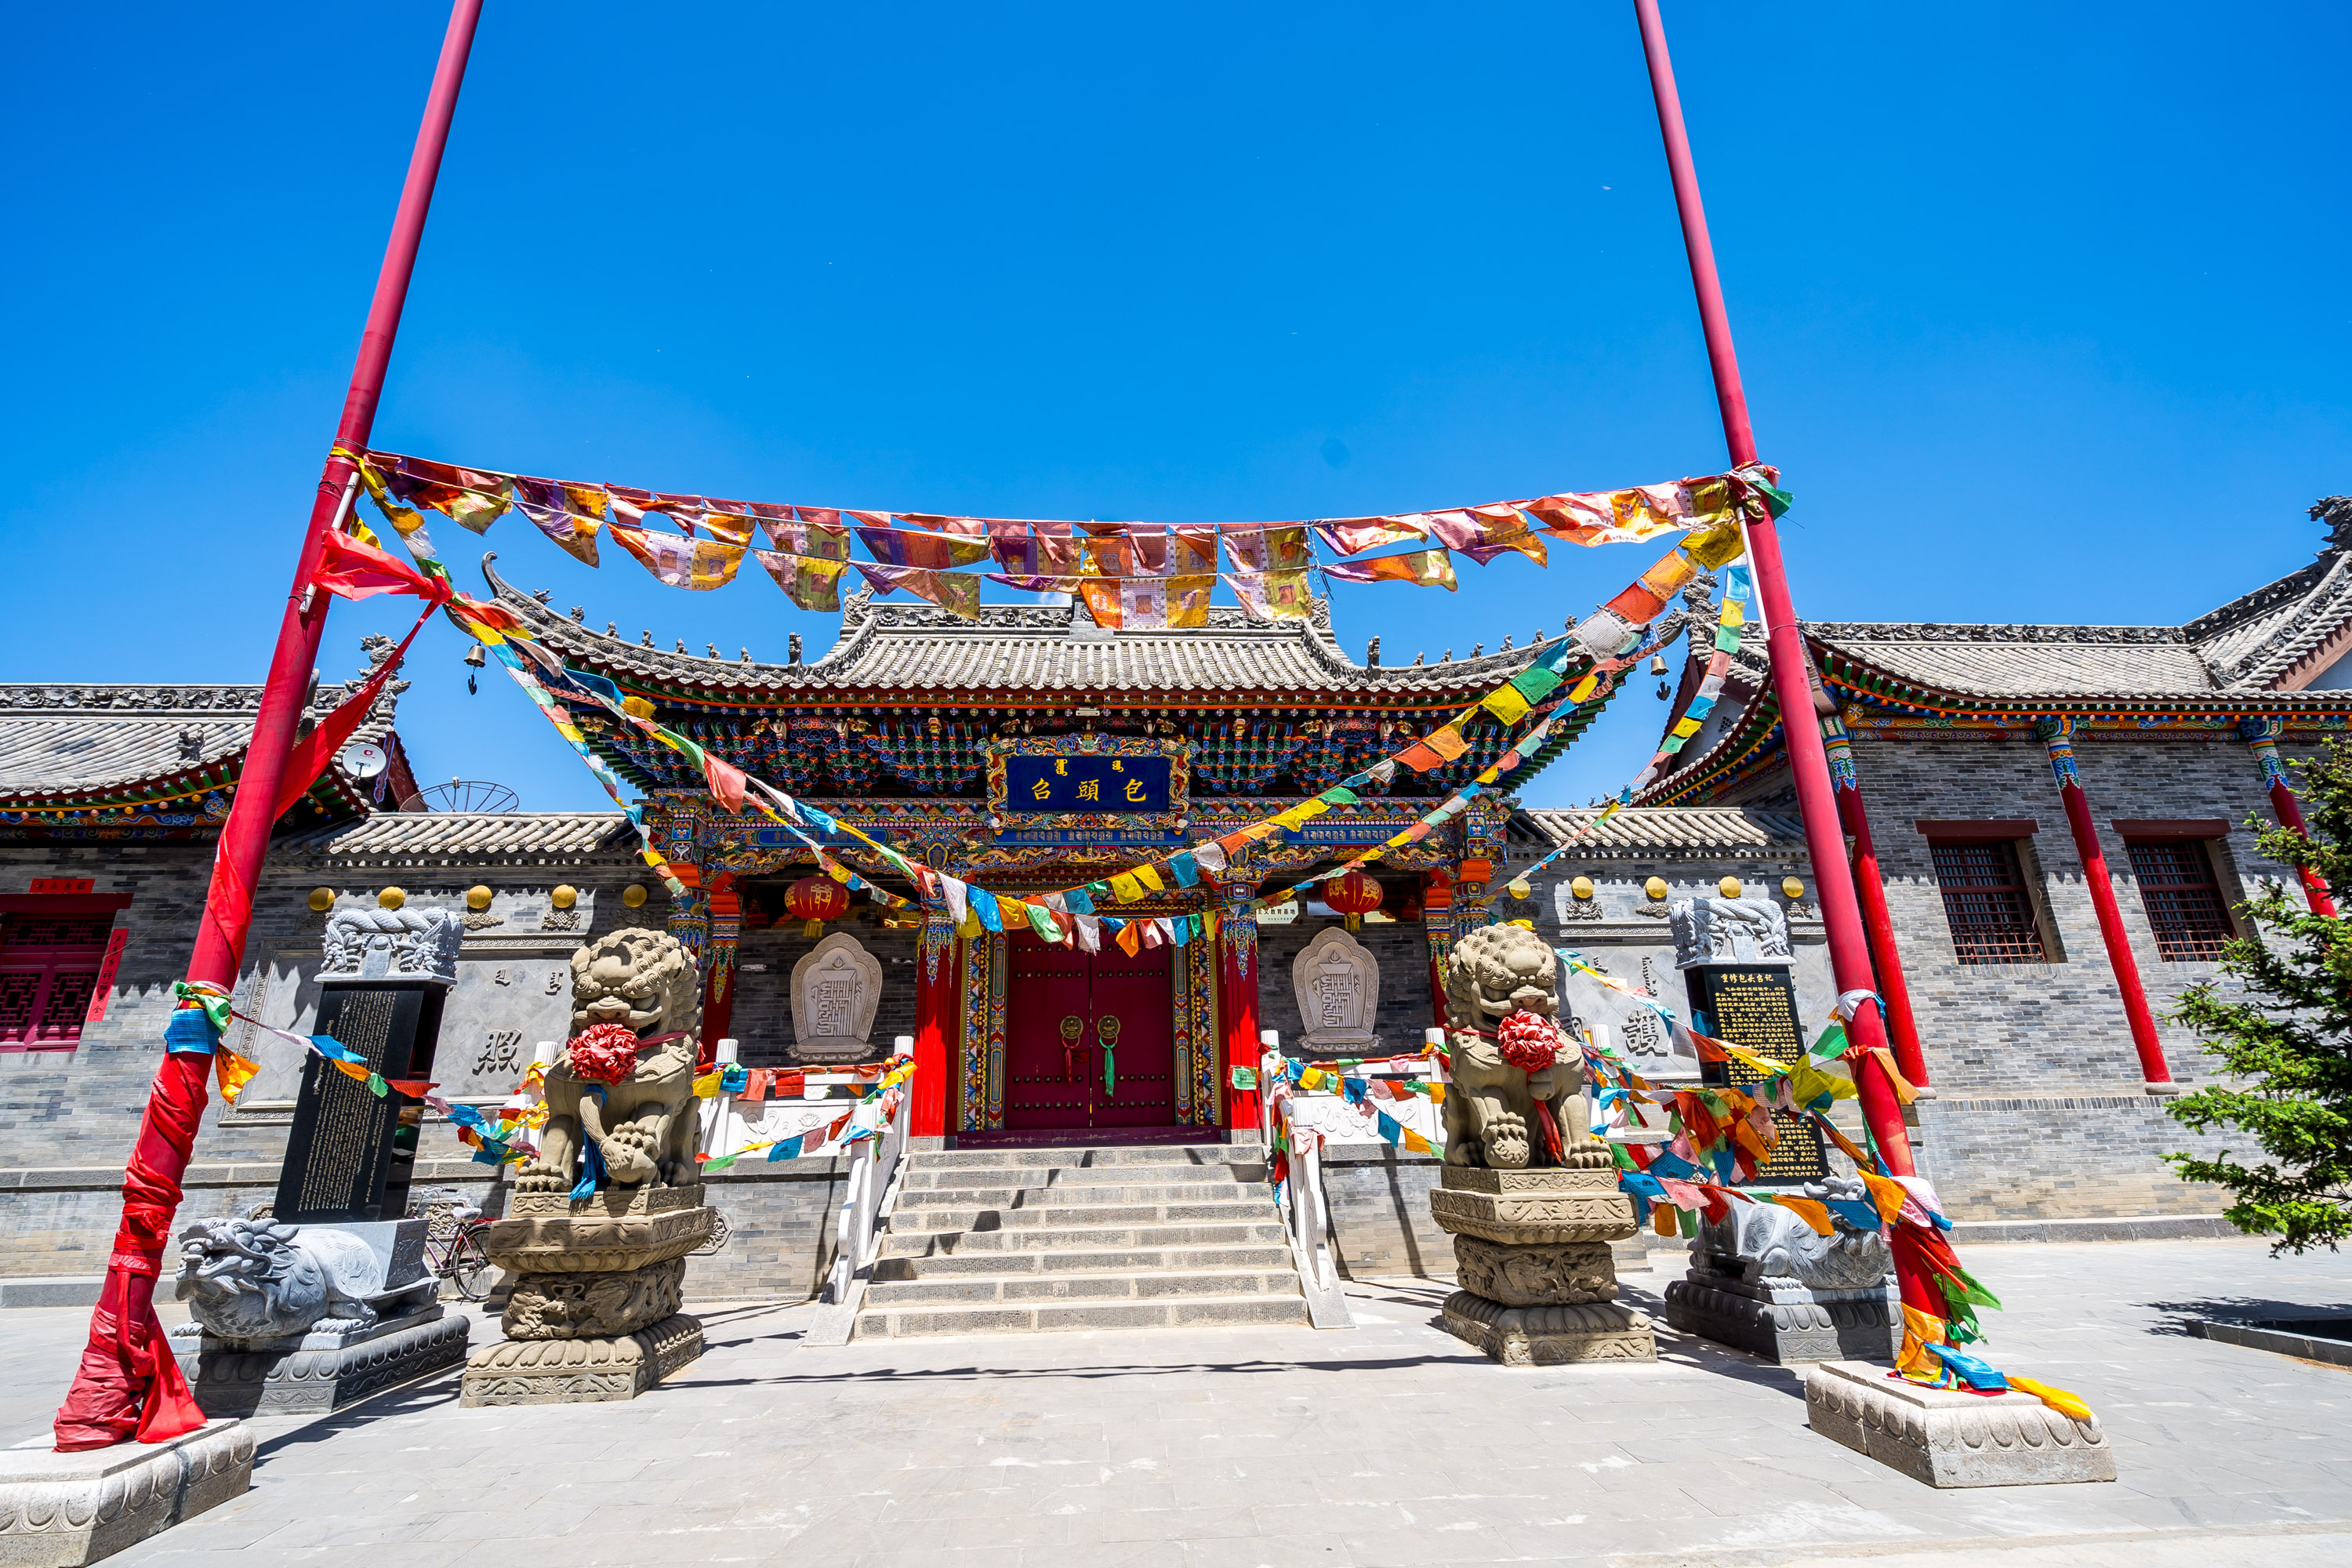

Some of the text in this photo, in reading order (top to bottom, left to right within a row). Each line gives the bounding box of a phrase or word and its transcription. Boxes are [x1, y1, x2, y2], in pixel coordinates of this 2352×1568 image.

[1720, 973, 1774, 983] 重修包头召记
[471, 1028, 523, 1076] 照
